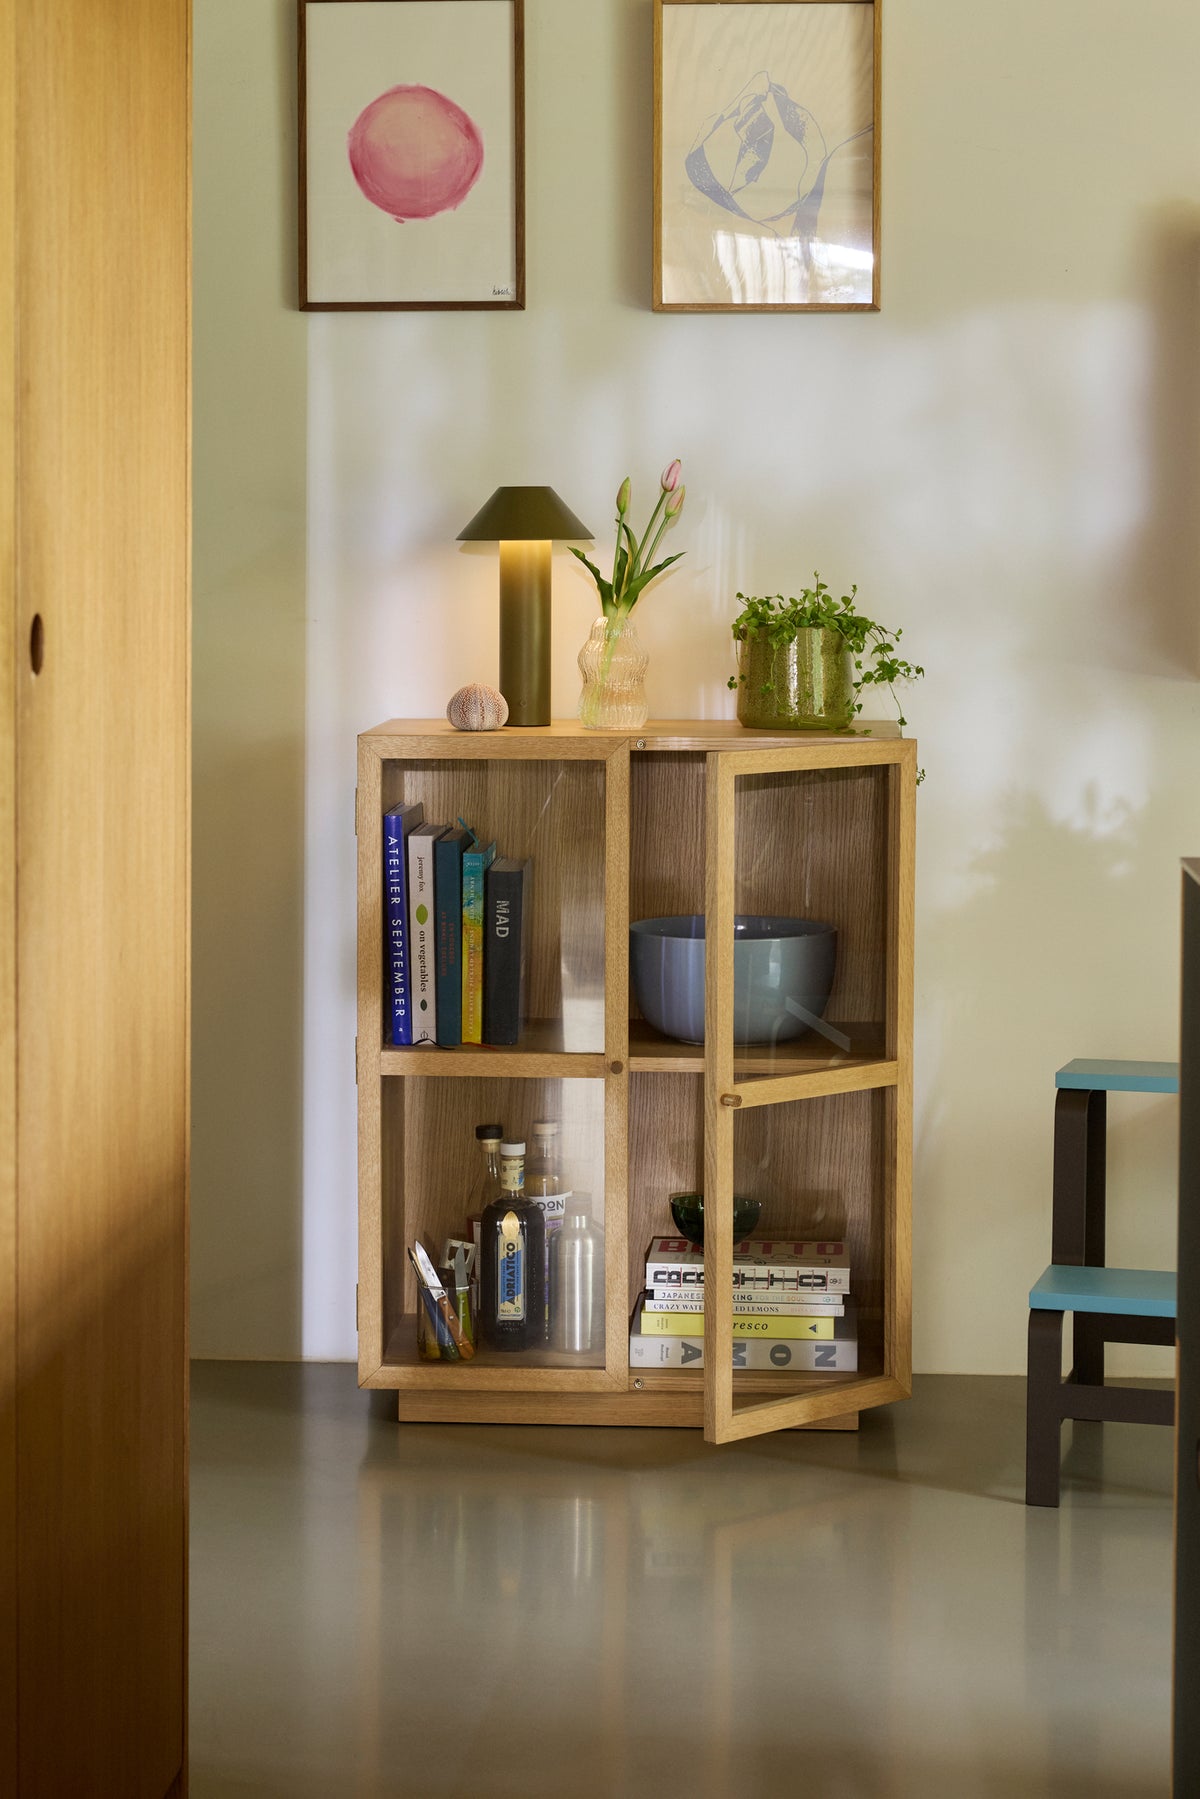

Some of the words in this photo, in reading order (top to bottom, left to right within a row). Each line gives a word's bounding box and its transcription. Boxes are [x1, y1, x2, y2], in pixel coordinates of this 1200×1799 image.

[388, 836, 401, 904] ATELIER
[419, 930, 426, 942] on
[496, 900, 510, 938] MAD
[392, 919, 406, 1017] SEPTEMBER
[418, 944, 428, 992] vegetables
[537, 1200, 564, 1212] DON
[658, 1240, 843, 1255] BTTO
[506, 1242, 516, 1305] ADRIATICO
[733, 1320, 768, 1330] resco
